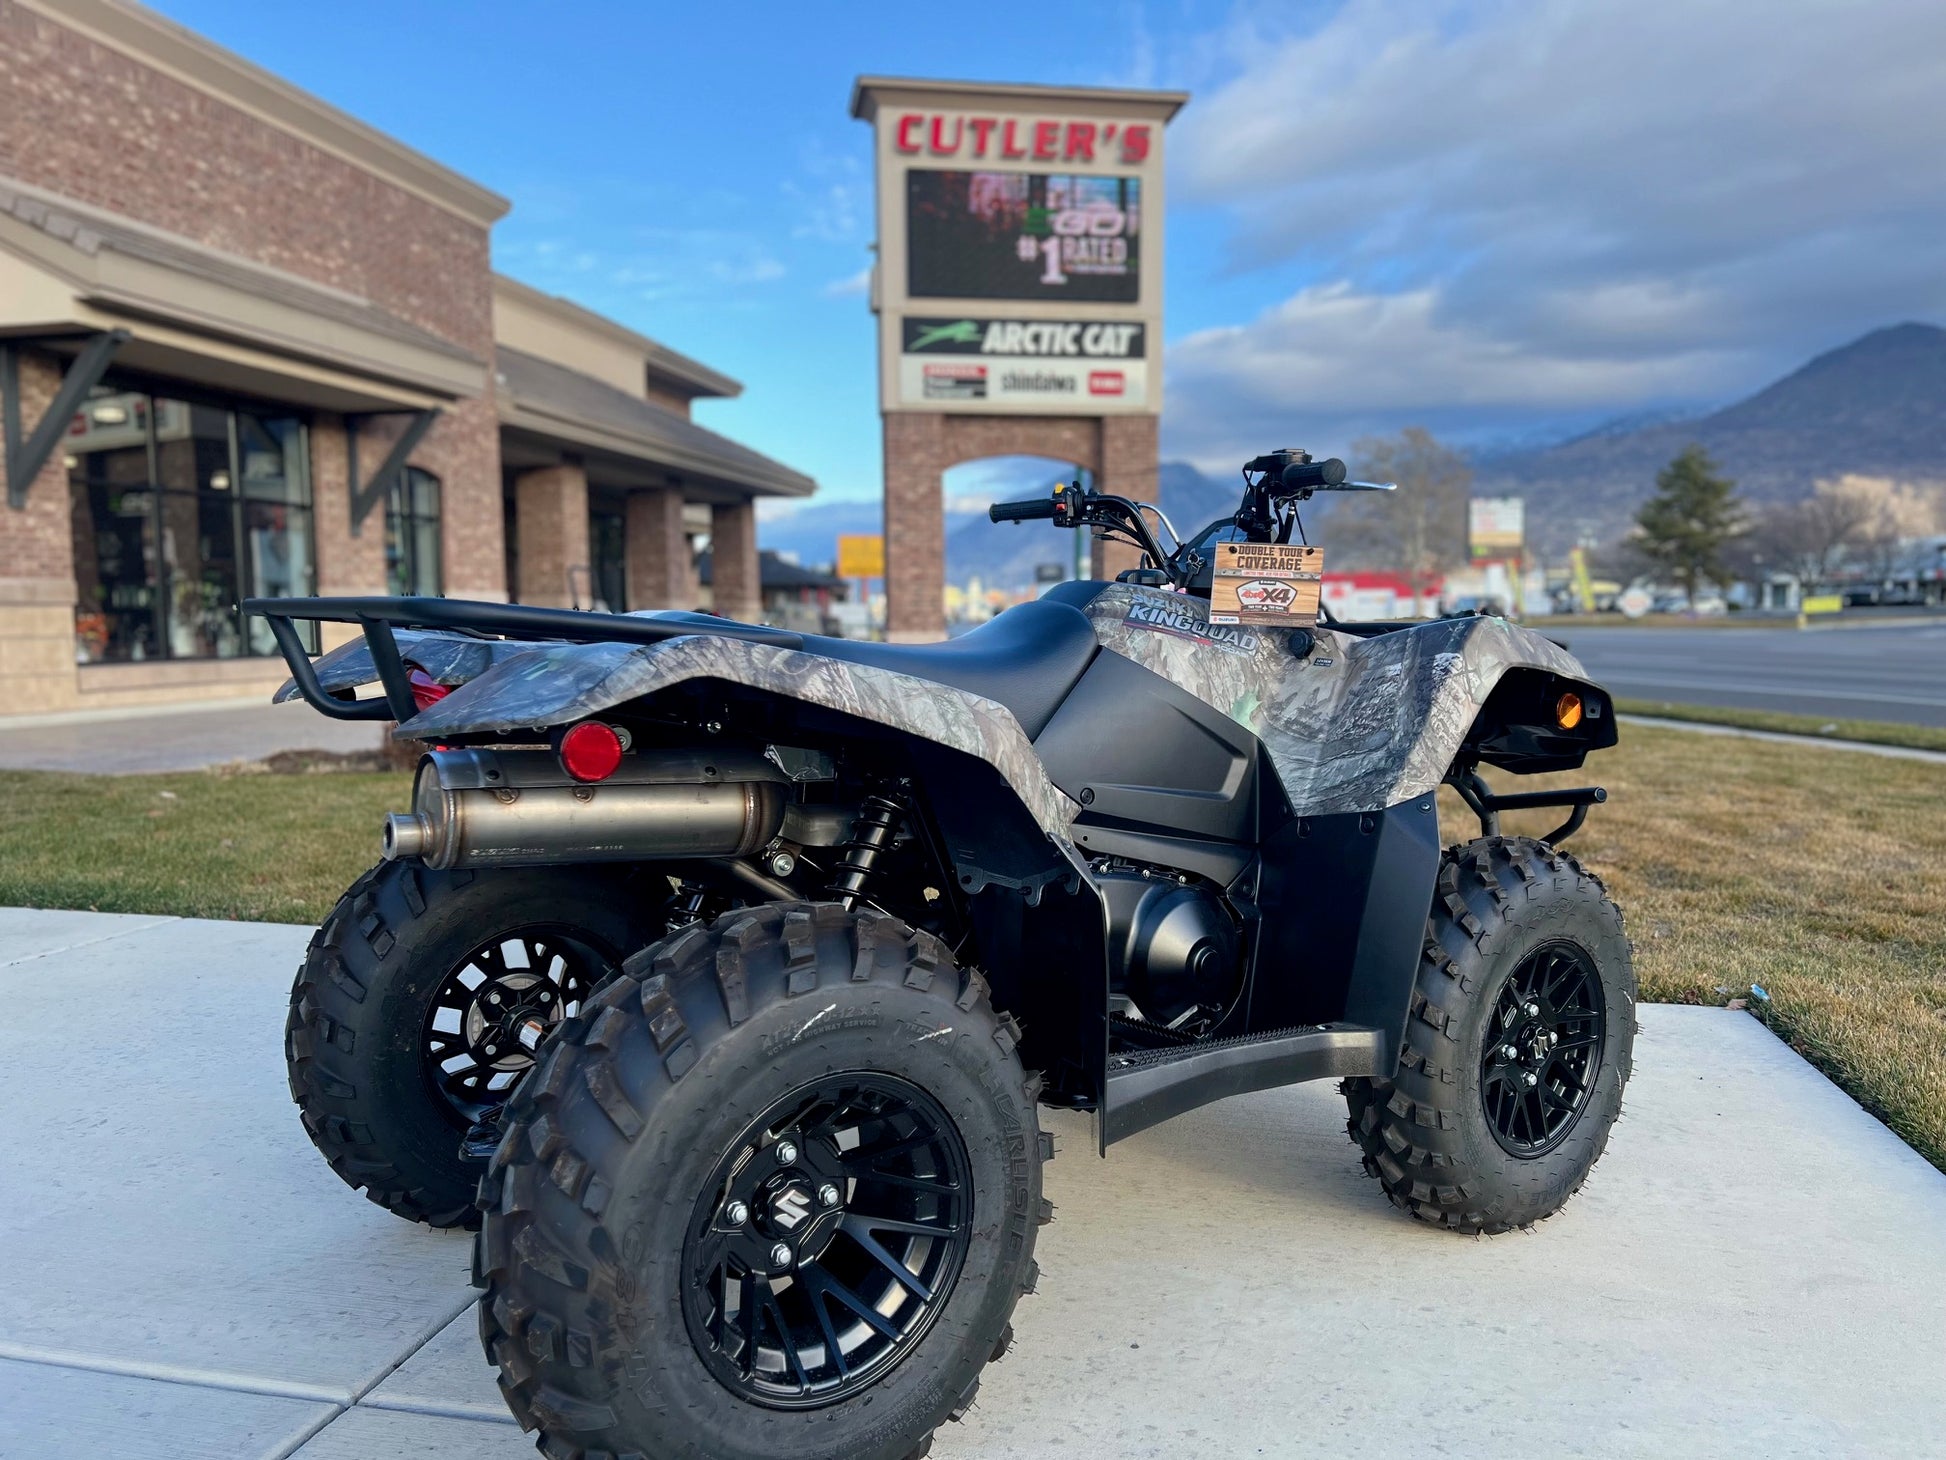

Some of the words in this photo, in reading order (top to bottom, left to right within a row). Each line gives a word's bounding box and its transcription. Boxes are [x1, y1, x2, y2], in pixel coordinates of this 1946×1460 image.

[897, 114, 1152, 163] CUTLER'S
[1063, 237, 1127, 264] RATED
[980, 321, 1082, 355] ARCTIC
[1082, 323, 1142, 356] CAT
[1237, 556, 1302, 571] COVERAGE
[1238, 546, 1274, 556] DOUBLE
[1279, 548, 1303, 558] YOUR
[1131, 594, 1194, 617] SUZUKI
[1129, 605, 1259, 651] KINGQUAD
[804, 1022, 842, 1039] HIGHWAY
[843, 1018, 877, 1028] SERVICE
[994, 1093, 1030, 1250] CARLISLE
